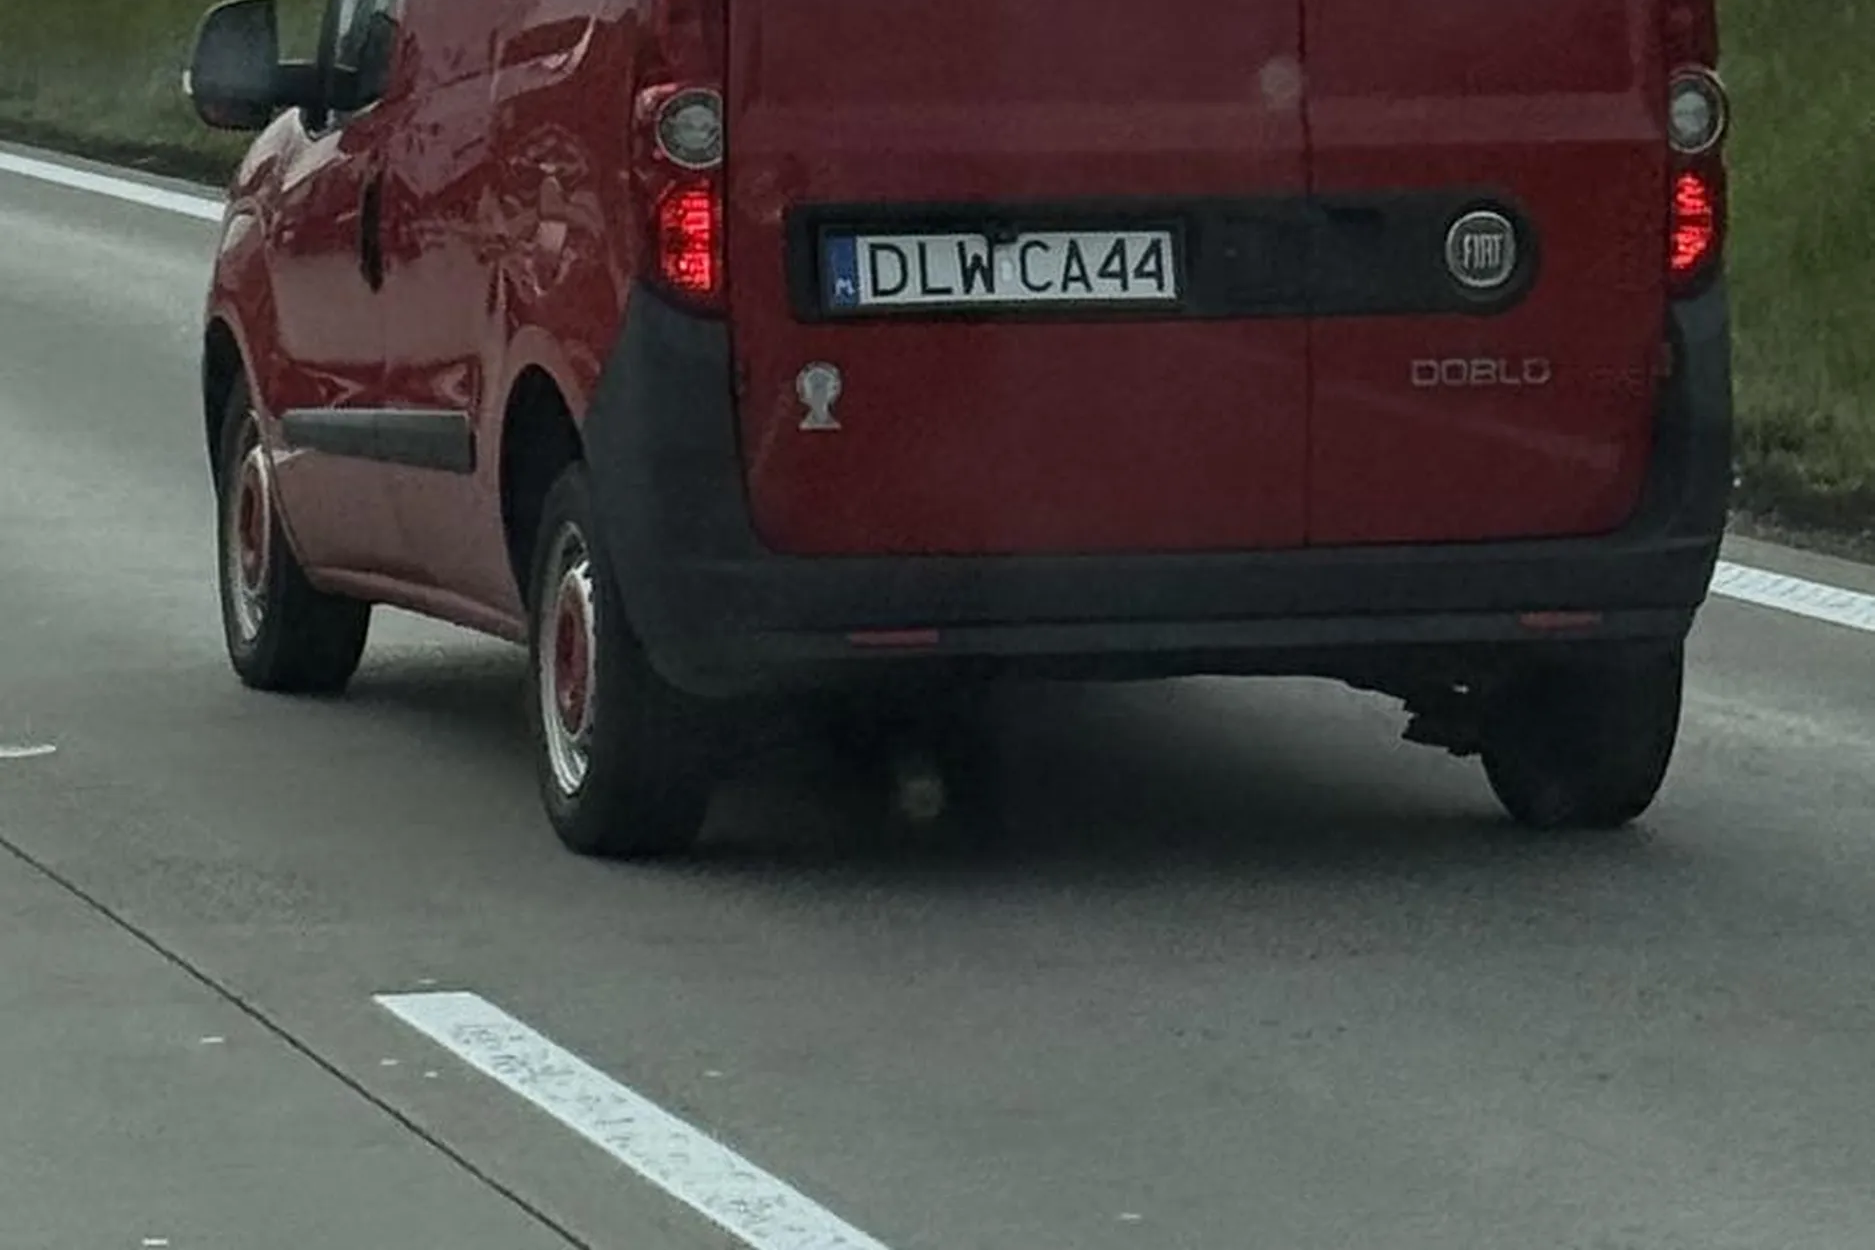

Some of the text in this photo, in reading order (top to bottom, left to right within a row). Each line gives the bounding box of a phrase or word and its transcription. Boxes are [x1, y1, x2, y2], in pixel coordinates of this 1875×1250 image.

[868, 238, 1166, 297] DLW CA44
[1463, 233, 1503, 269] FIAT
